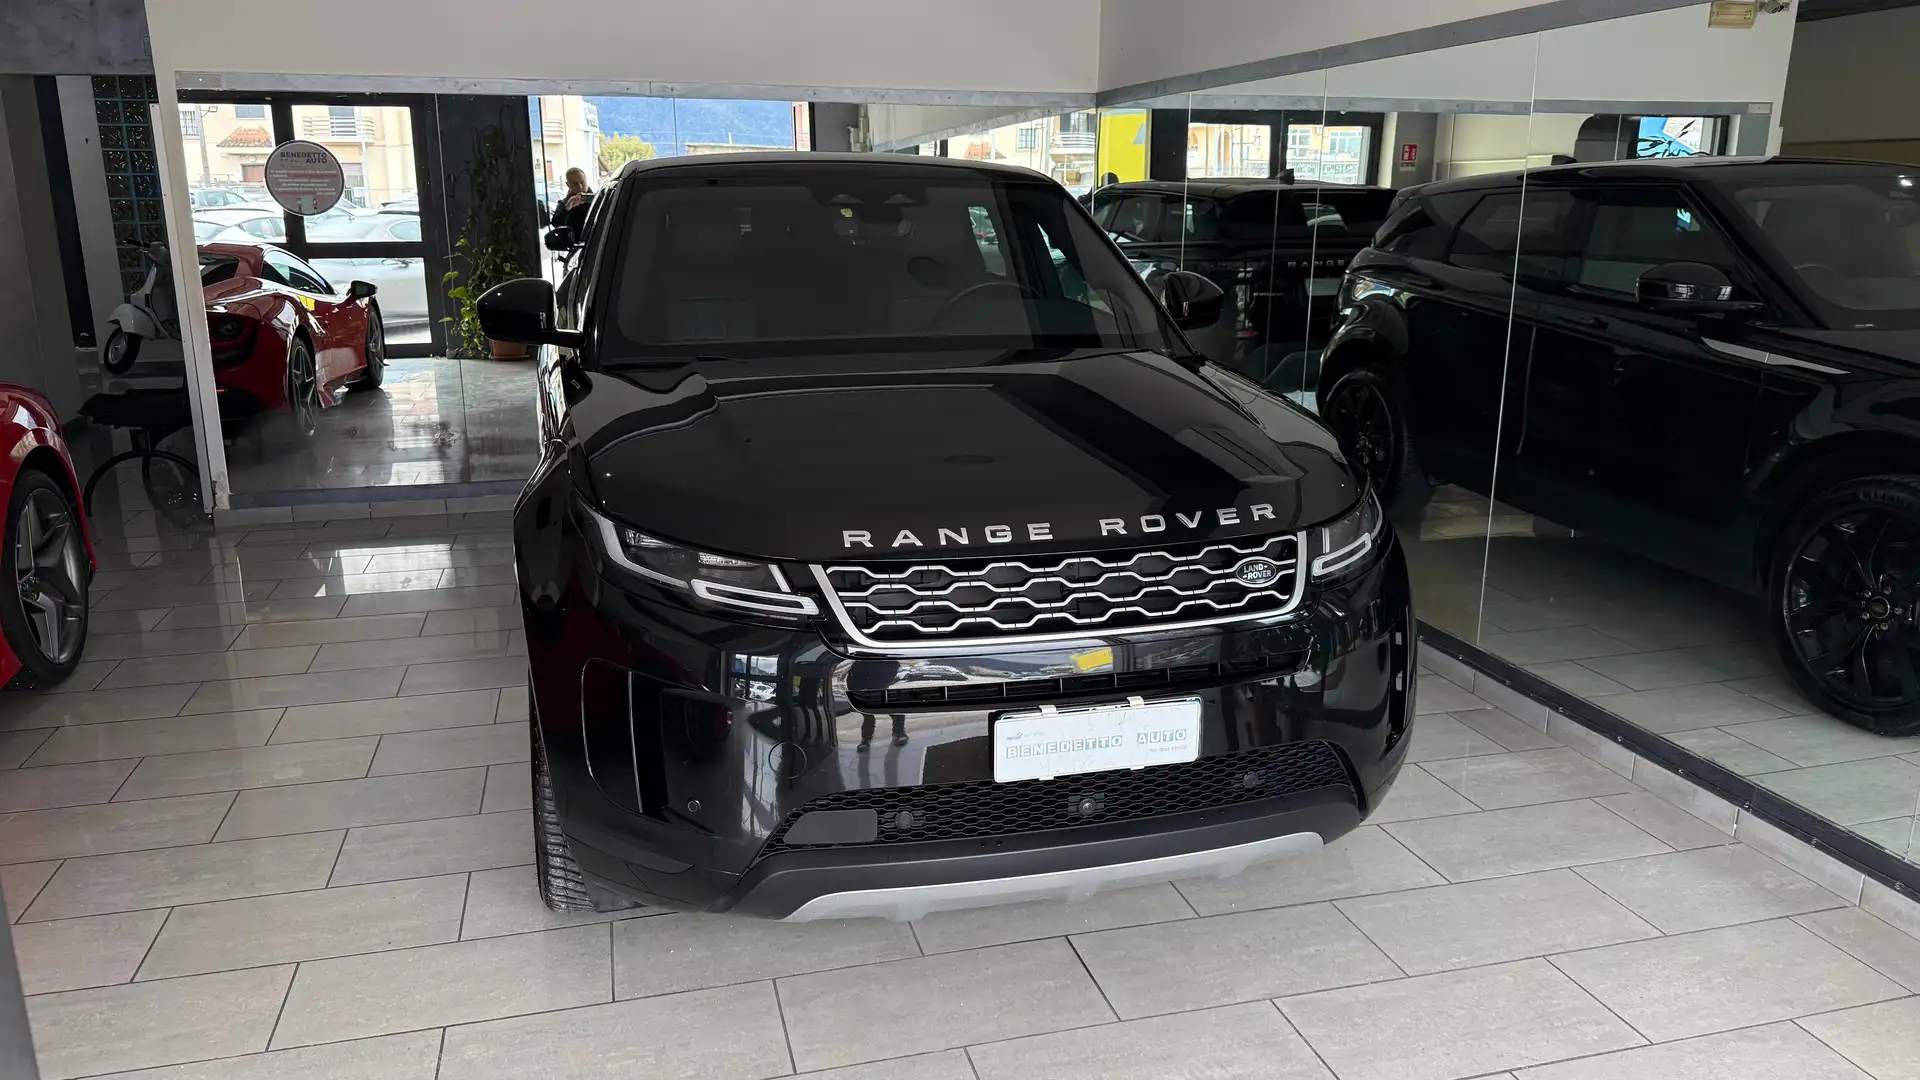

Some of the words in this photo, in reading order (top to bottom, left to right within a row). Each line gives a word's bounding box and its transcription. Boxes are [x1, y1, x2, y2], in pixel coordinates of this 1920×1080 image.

[1287, 260, 1345, 268] RANGE
[842, 521, 1054, 548] RANGE
[1099, 503, 1277, 537] ROVER
[1243, 563, 1263, 573] LAND
[1247, 569, 1271, 580] ROVER
[1006, 735, 1123, 758] BENEDETTO
[1136, 728, 1187, 744] AUTO
